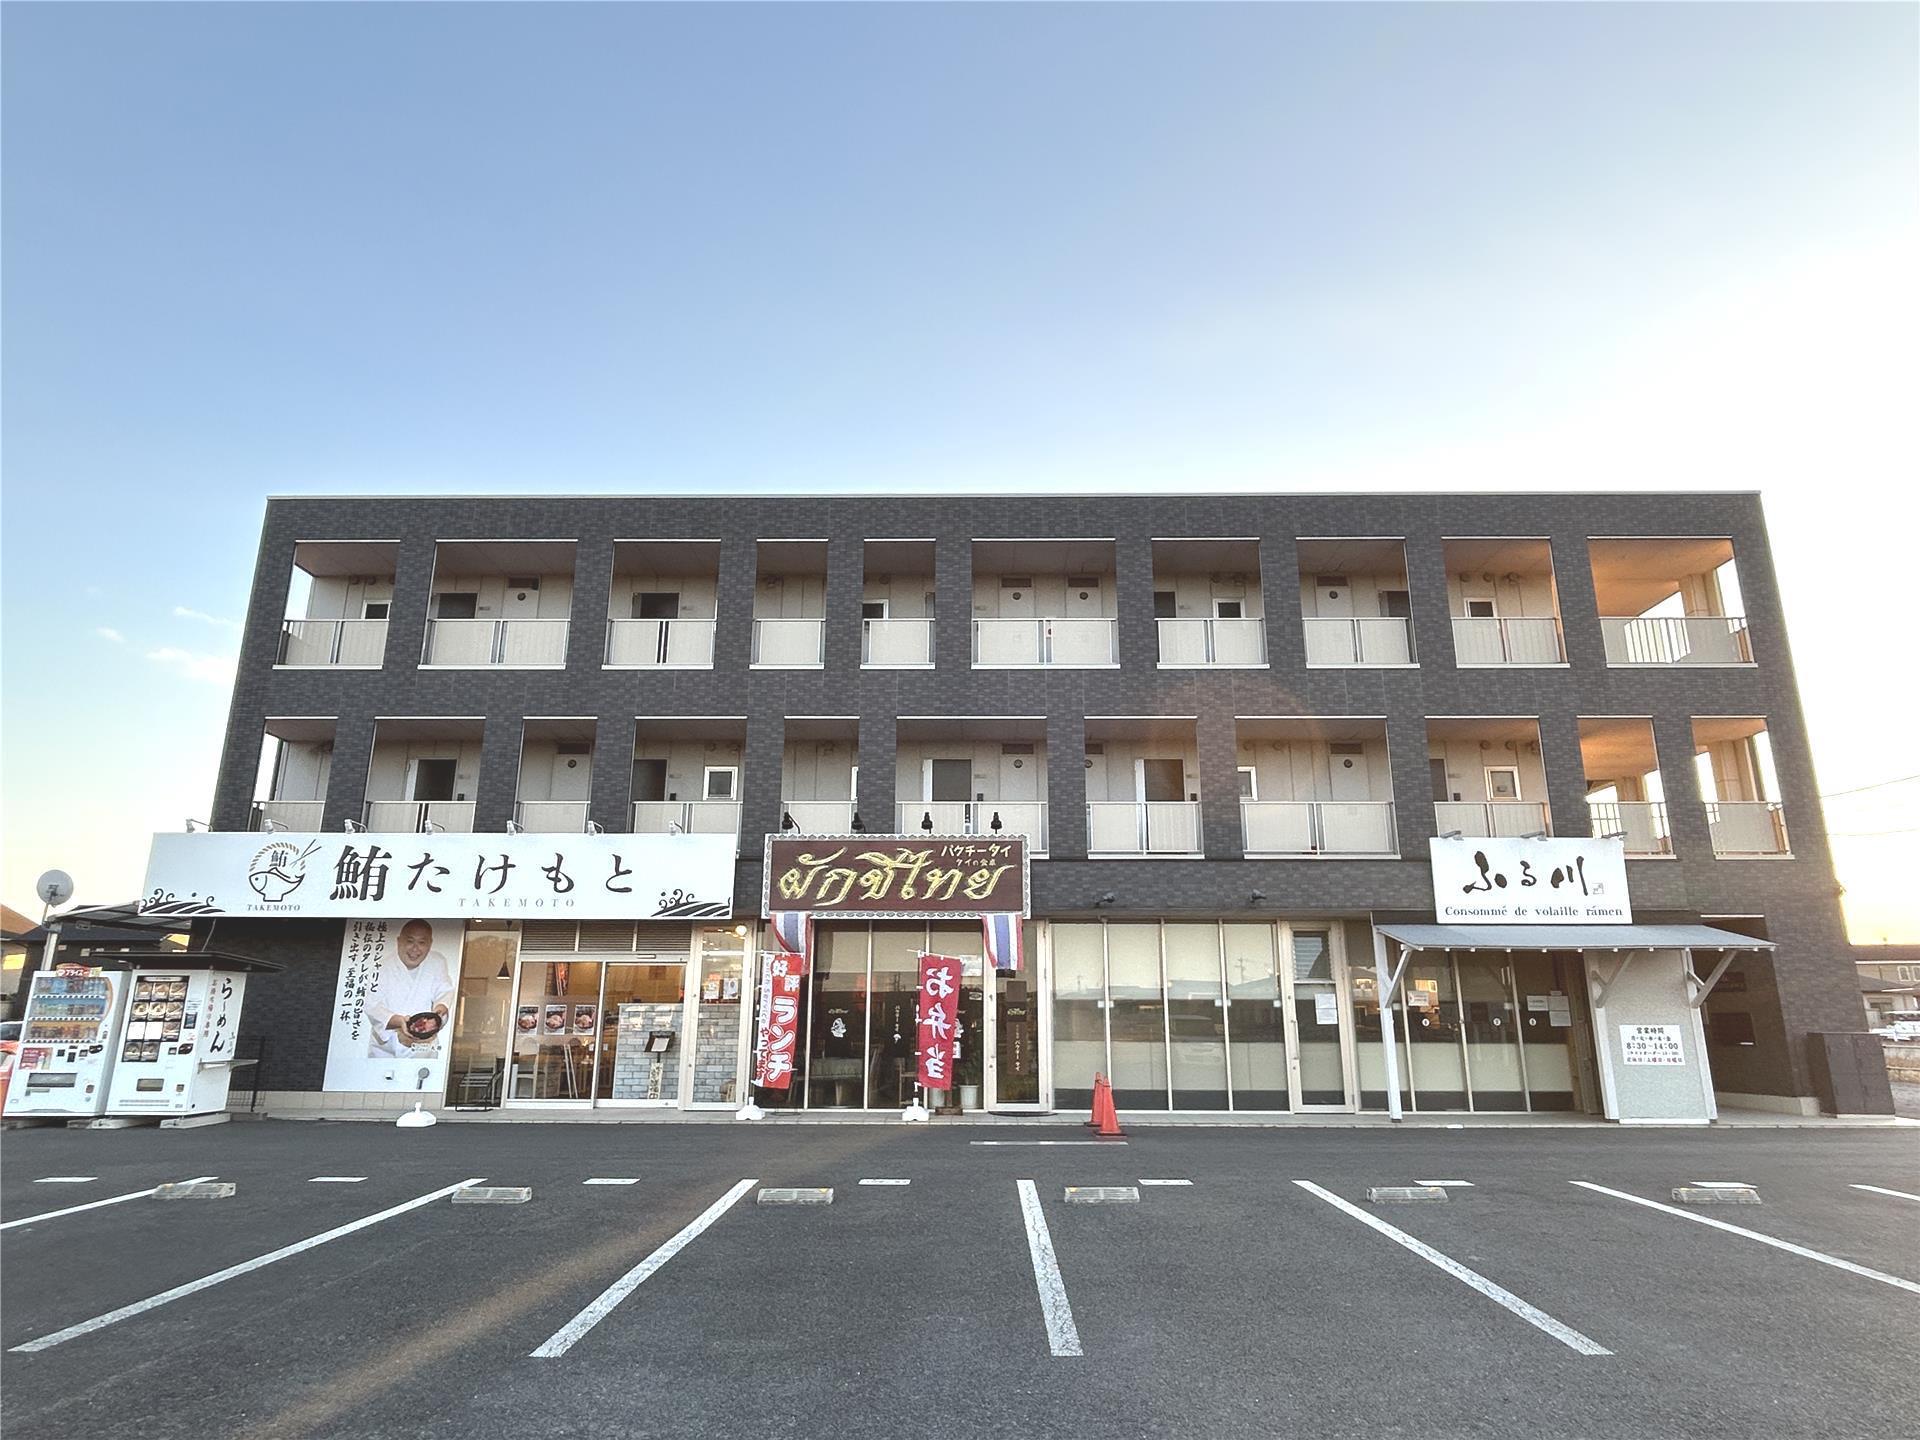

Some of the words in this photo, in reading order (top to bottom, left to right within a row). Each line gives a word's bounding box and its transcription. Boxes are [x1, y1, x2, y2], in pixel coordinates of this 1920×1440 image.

[940, 843, 1012, 858] パクチータイ
[330, 845, 632, 901] 鮪たけもと
[247, 903, 301, 912] TAKEMOTO
[459, 897, 575, 908] TAKEMOTO
[1445, 904, 1508, 917] Consommé
[1514, 905, 1528, 916] de
[1535, 905, 1579, 916] volaille
[369, 921, 388, 993] 極上のシャリと
[209, 977, 233, 1054] らーめん
[922, 966, 954, 1079] お弁当
